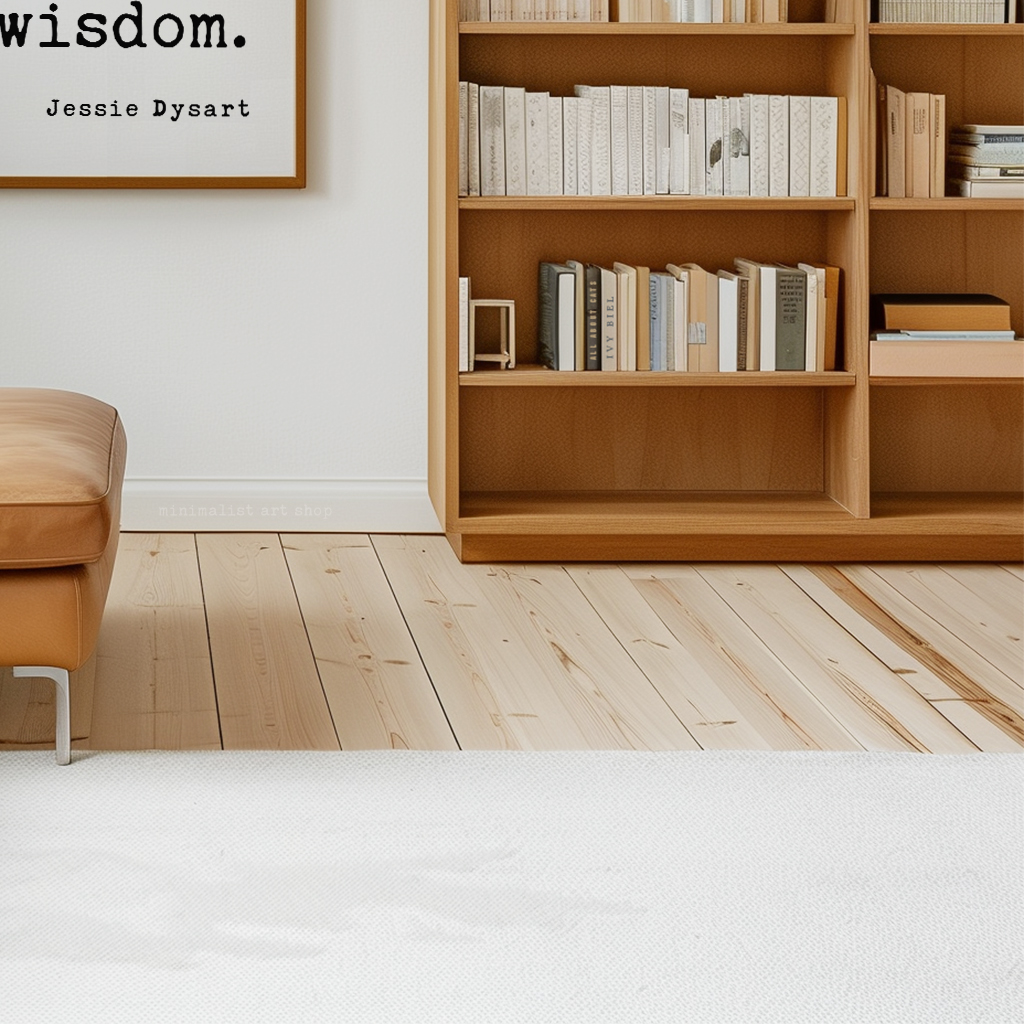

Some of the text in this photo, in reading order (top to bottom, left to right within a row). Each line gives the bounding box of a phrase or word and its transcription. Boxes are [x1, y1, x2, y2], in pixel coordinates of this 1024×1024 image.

[47, 99, 249, 121] Jessie Dysart
[589, 281, 597, 361] ALL ABOUT CATS
[606, 296, 614, 359] IVY BIEL
